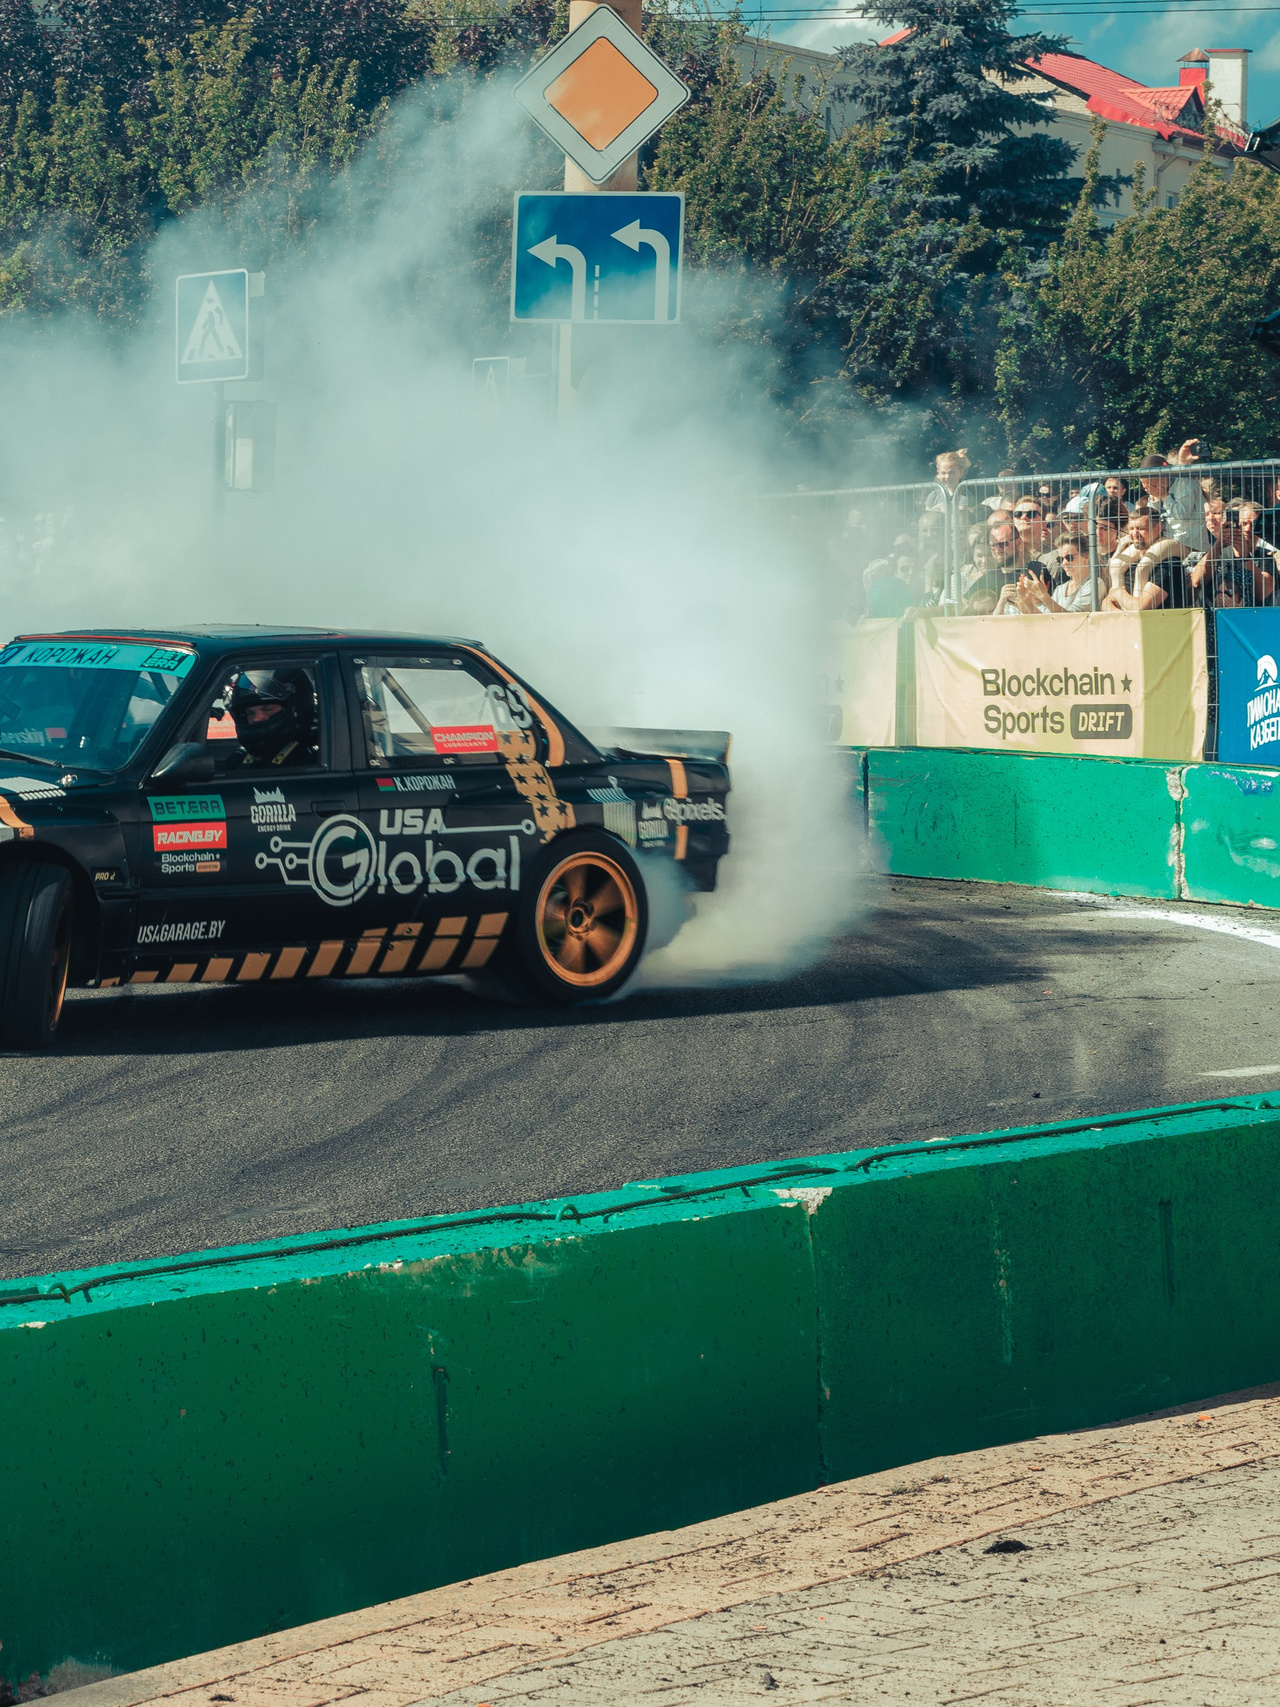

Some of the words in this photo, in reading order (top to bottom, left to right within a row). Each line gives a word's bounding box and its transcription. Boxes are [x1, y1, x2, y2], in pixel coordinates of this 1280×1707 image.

[21, 647, 118, 665] КОРОЖАН
[981, 667, 1115, 697] Blockchain
[486, 683, 534, 731] 69
[984, 704, 1065, 740] Sports
[1078, 711, 1125, 732] DRIFT
[434, 732, 494, 743] CHAMPION
[250, 803, 297, 824] GORILLA
[379, 808, 445, 836] USA
[157, 829, 223, 845] RACING.BY
[161, 852, 215, 863] Blockchain
[161, 862, 195, 874] Sports
[316, 825, 520, 900] Global
[95, 872, 109, 881] PRO
[137, 920, 226, 943] USAGARAGE.BY
